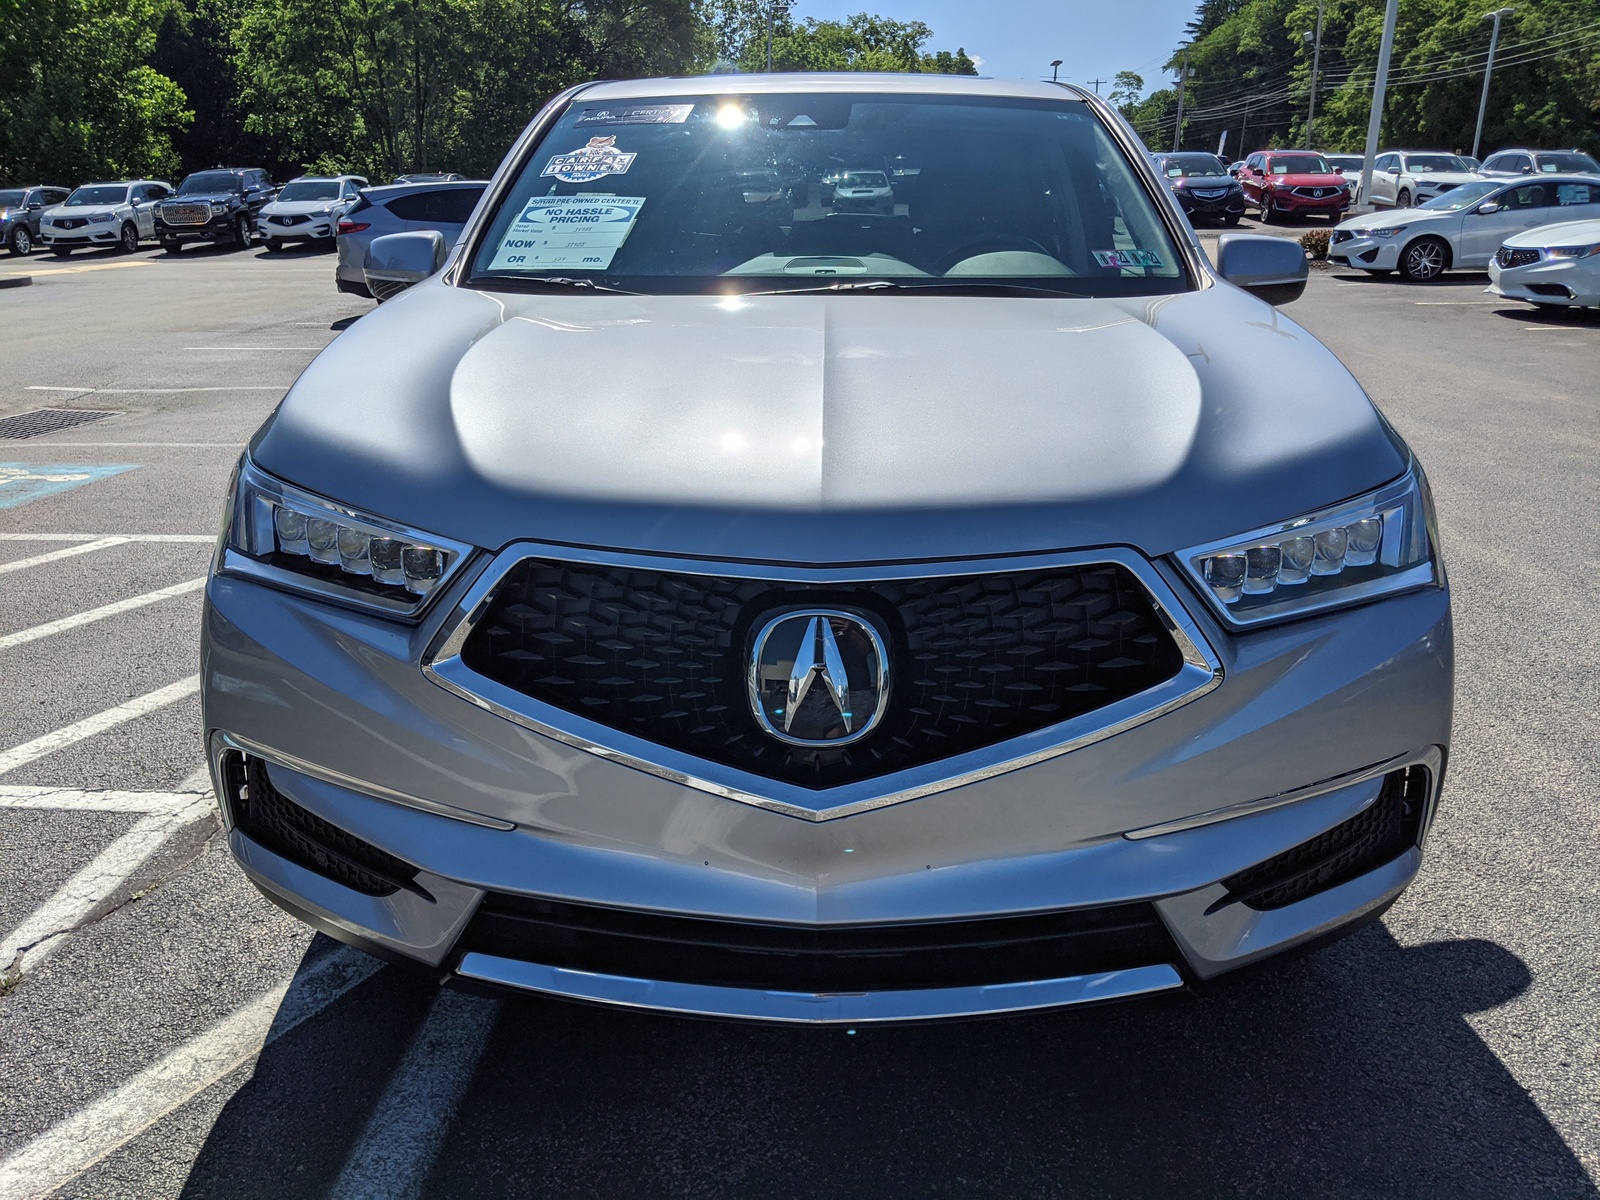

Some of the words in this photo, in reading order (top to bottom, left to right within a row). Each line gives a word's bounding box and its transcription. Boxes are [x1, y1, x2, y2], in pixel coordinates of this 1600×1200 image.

[554, 156, 628, 164] CARFAX
[561, 164, 623, 172] OWNER
[565, 207, 614, 215] HASSLE
[549, 215, 600, 224] PRICING
[504, 239, 536, 248] NOW
[507, 255, 526, 263] OR
[1100, 254, 1109, 264] 8
[1131, 253, 1141, 264] 8
